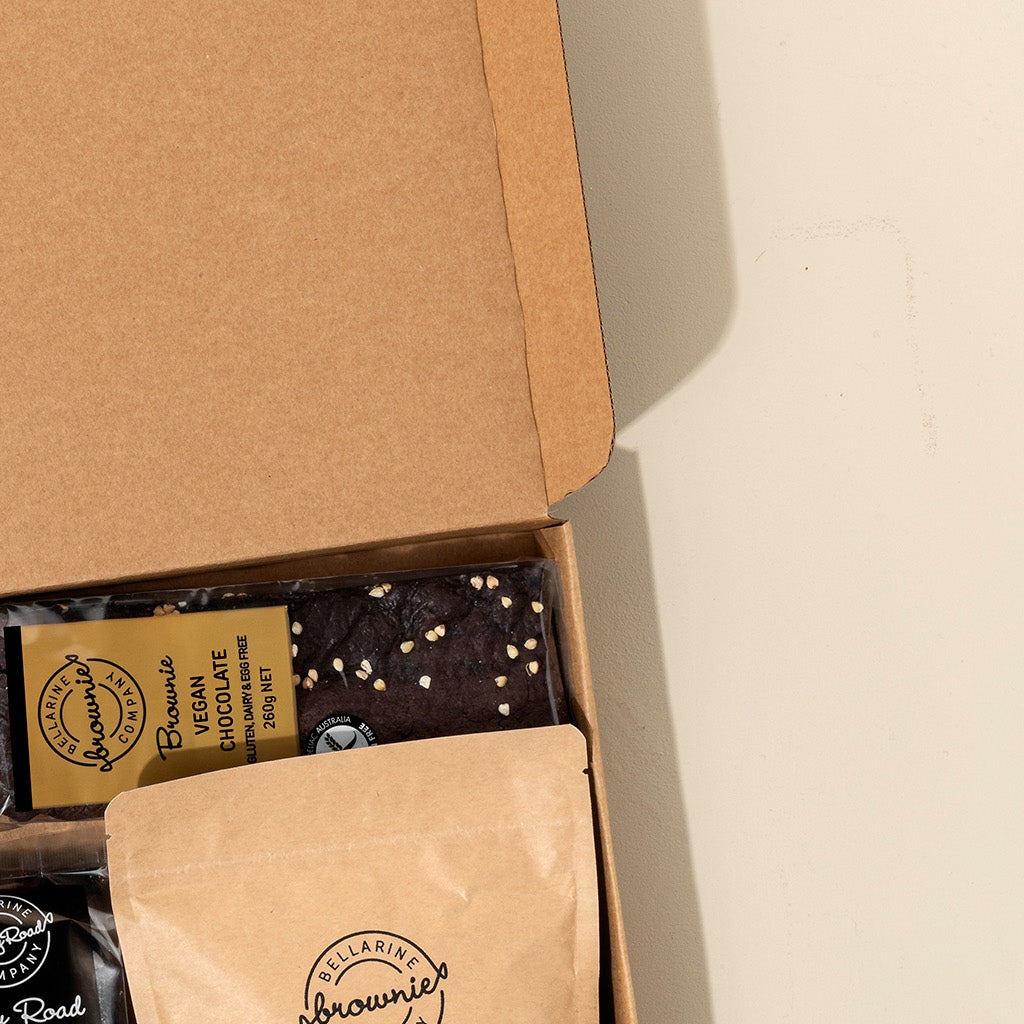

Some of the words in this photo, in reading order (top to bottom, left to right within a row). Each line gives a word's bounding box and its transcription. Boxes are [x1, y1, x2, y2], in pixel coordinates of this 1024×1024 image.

[237, 635, 248, 660] FREE
[240, 662, 250, 681] EGG
[260, 667, 272, 692] NET
[42, 675, 76, 755] BELLARINE
[64, 654, 112, 771] brownie
[107, 671, 138, 743] COMPANY
[156, 655, 183, 760] Brownie
[190, 676, 210, 735] VEGAN
[213, 649, 236, 752] CHOCOLATE
[242, 692, 254, 720] DAIRY
[262, 696, 276, 729] 260g
[245, 722, 257, 764] GLUTEN,
[316, 716, 351, 733] AUSTRALIA
[359, 723, 375, 741] FREE
[319, 940, 419, 983] BELLARINE
[13, 995, 86, 1024] Road
